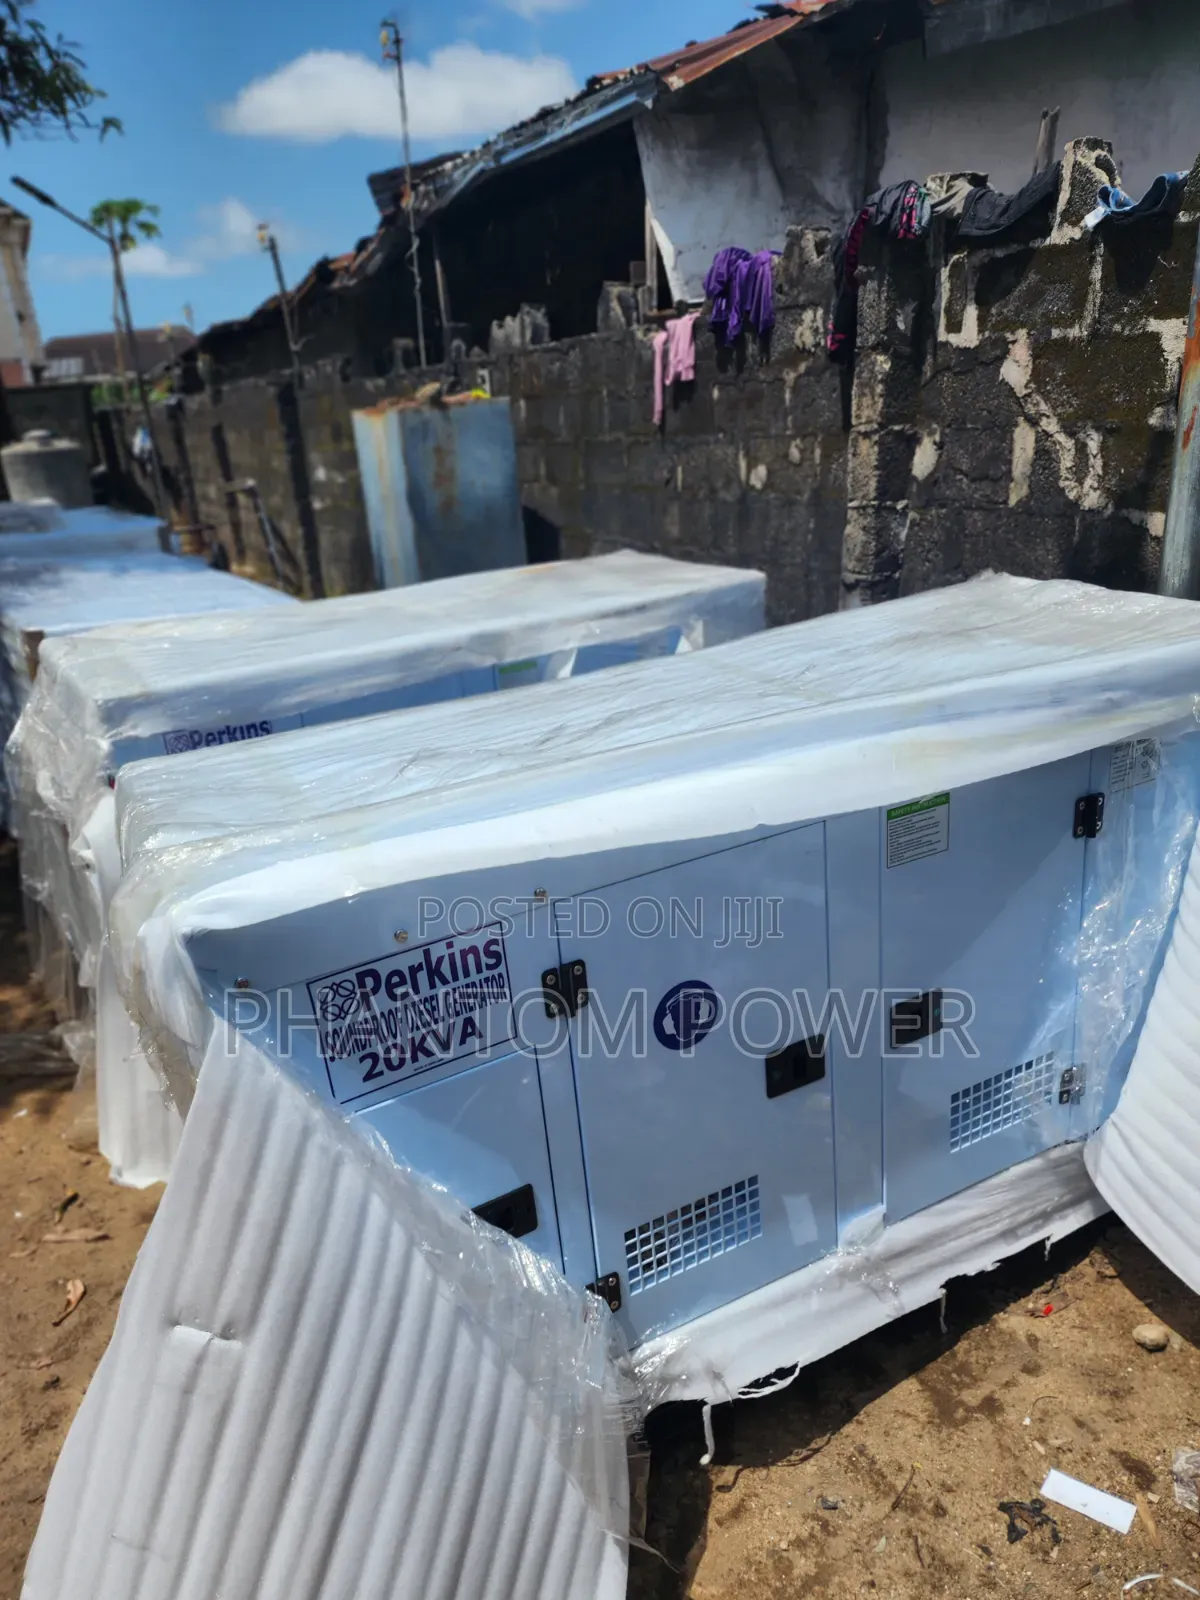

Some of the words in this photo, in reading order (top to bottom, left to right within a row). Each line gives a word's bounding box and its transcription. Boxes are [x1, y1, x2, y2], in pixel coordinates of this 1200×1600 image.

[188, 720, 271, 750] Perkins
[355, 938, 503, 1011] Perkins
[325, 1006, 402, 1062] SOUNDPROOF
[404, 993, 445, 1033] DIESEL
[446, 973, 507, 1018] GENERATOR
[359, 1016, 483, 1083] 20KVA
